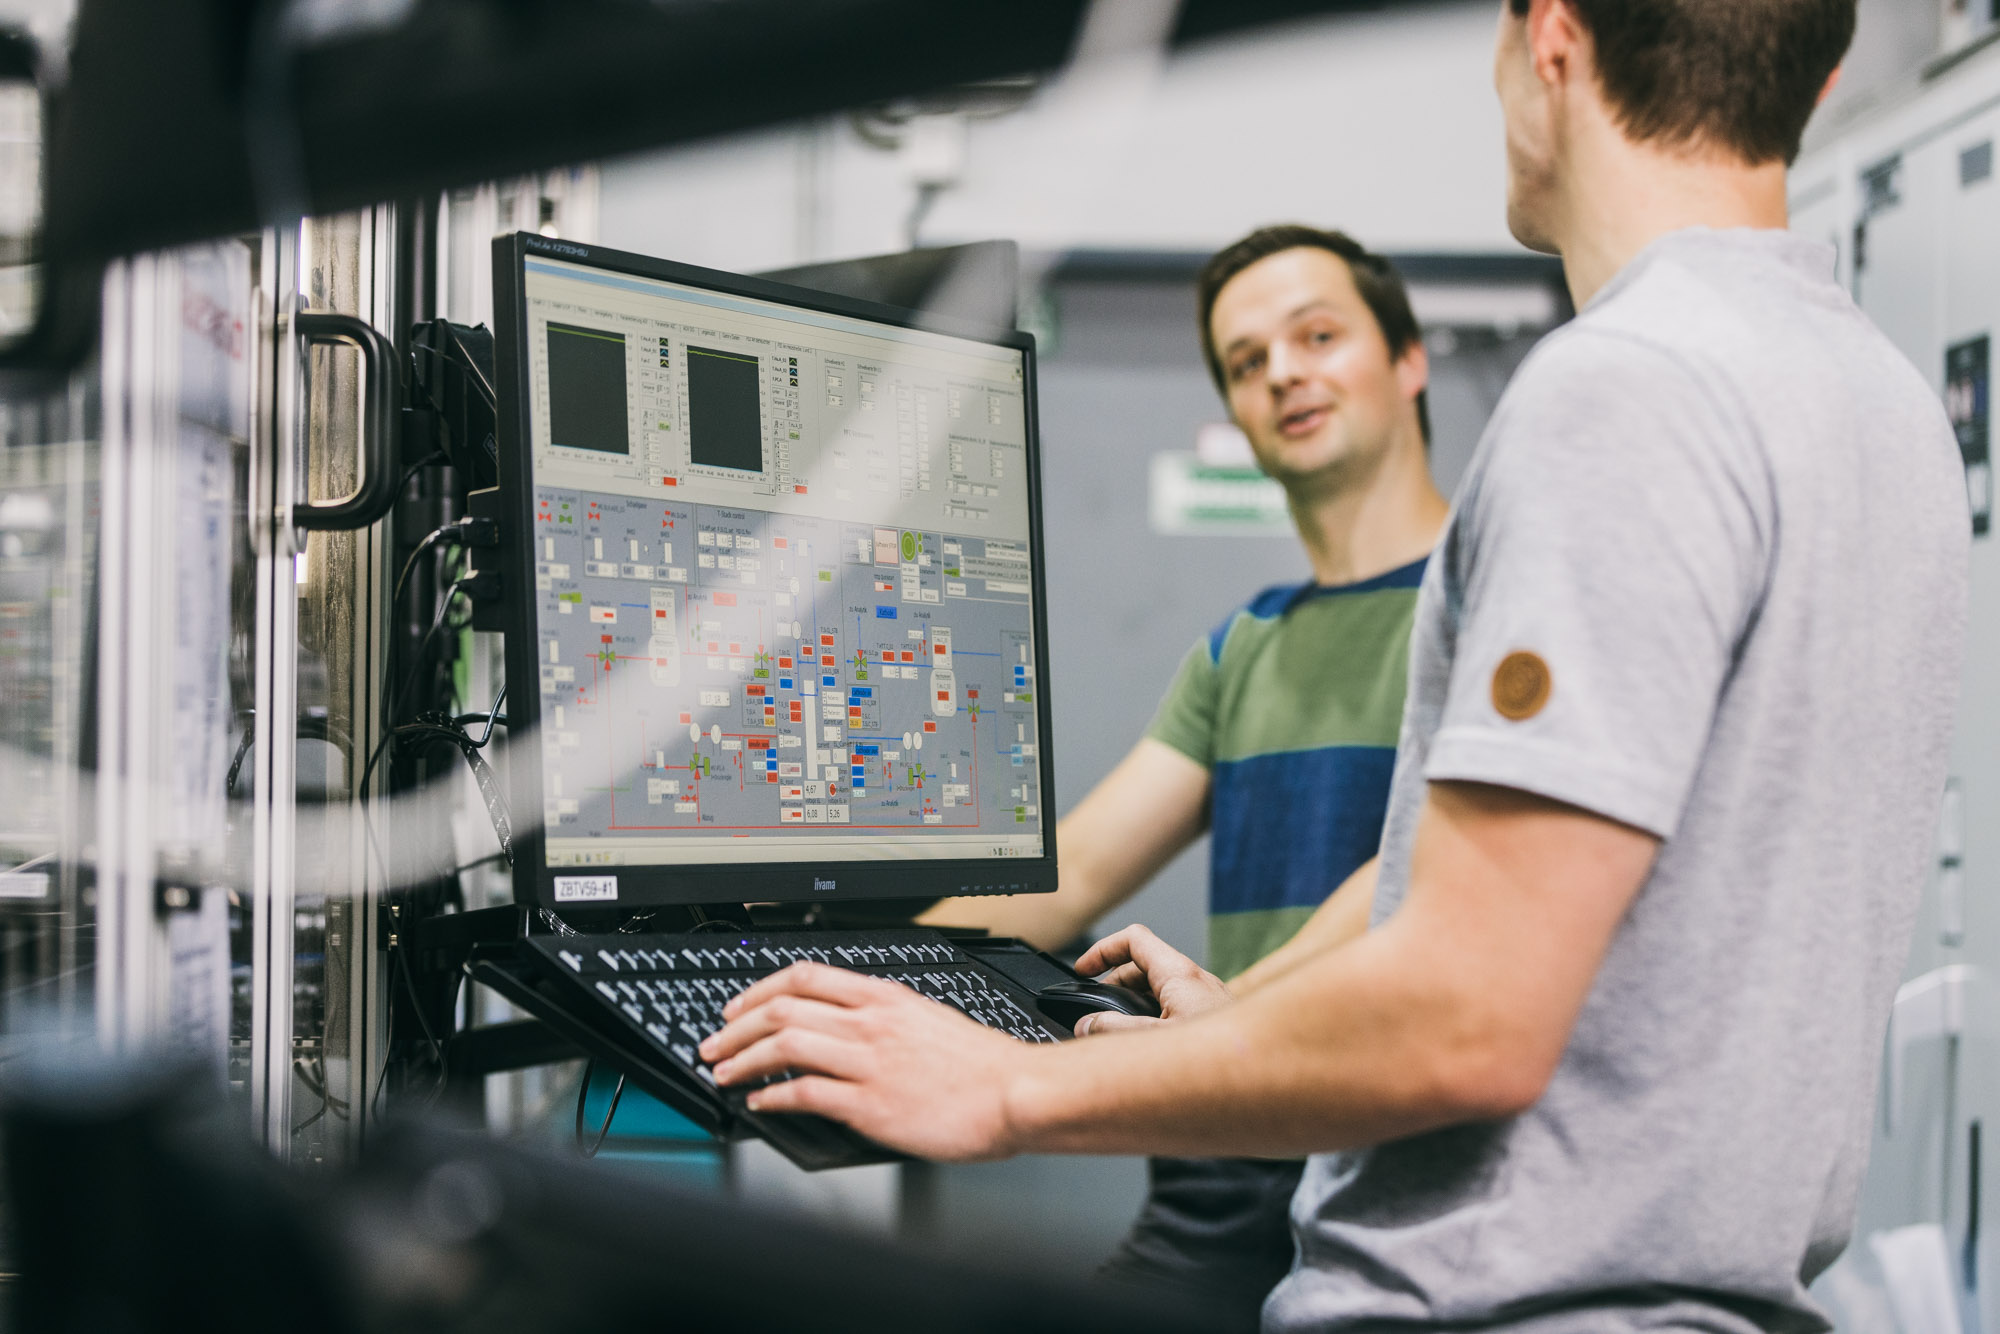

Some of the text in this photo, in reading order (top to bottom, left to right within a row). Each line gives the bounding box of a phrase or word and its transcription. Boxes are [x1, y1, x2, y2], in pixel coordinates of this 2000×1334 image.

[805, 784, 817, 796] 4,67
[806, 809, 818, 820] 6,08
[829, 809, 841, 820] 5,26
[559, 880, 613, 897] ZBTV59-#1
[814, 877, 836, 891] iiyama
